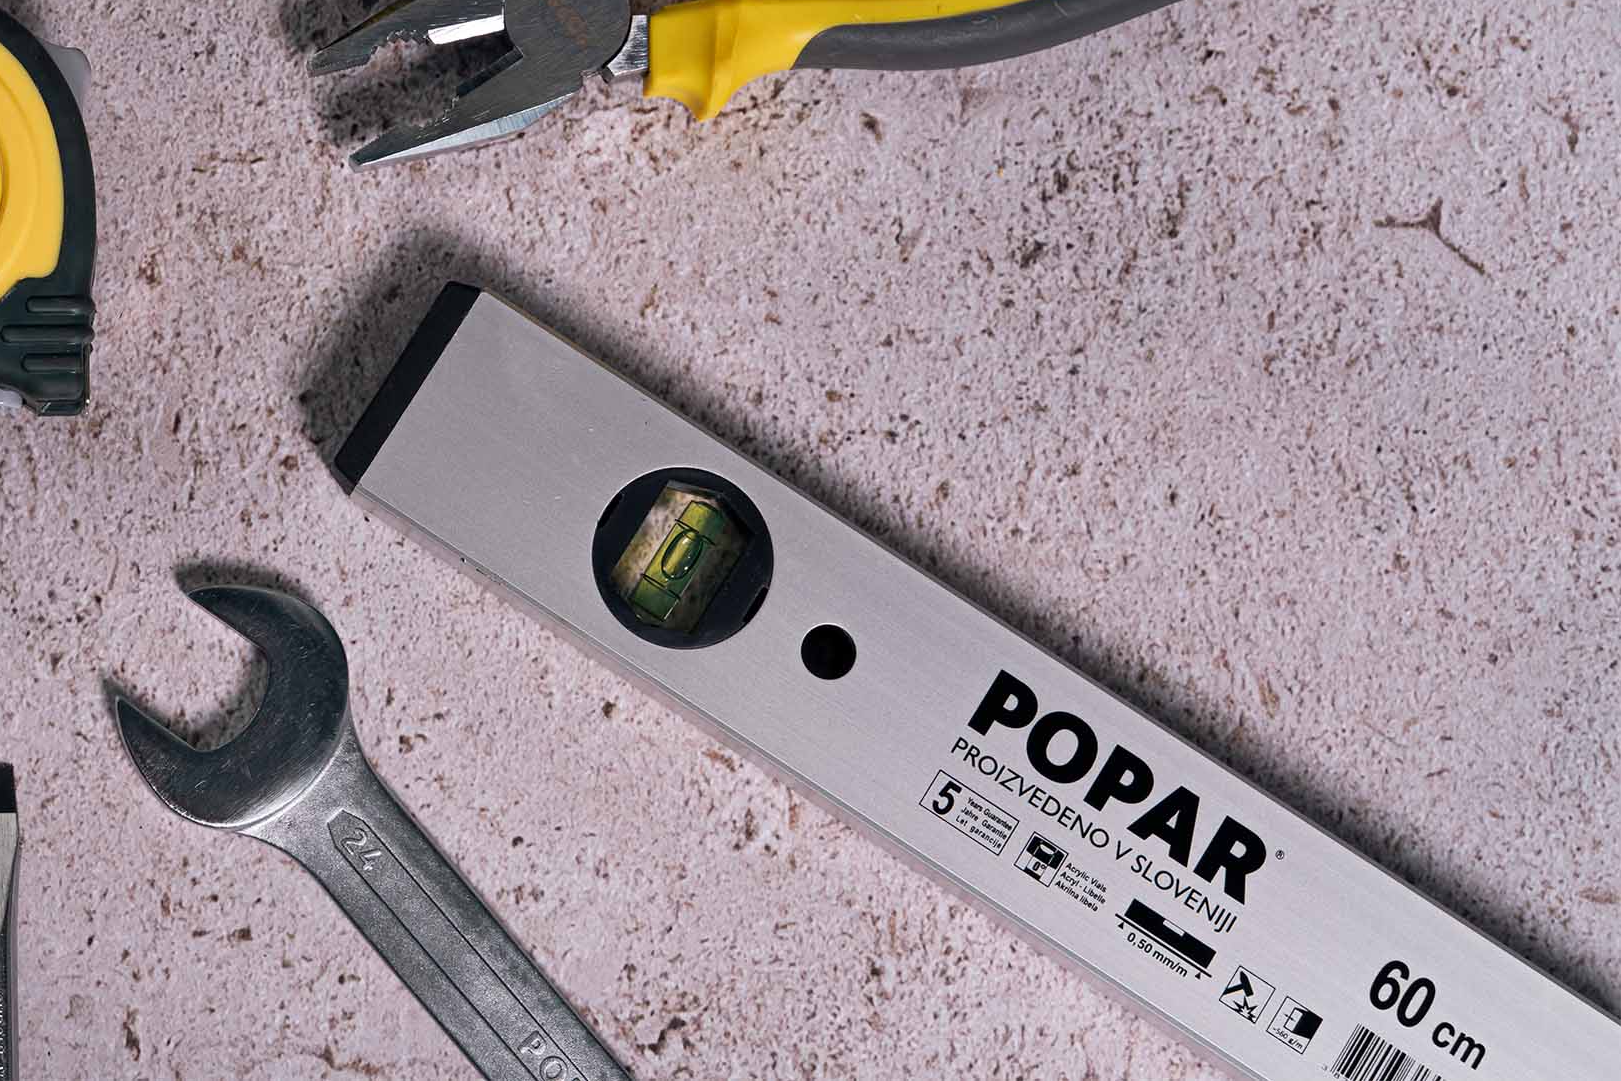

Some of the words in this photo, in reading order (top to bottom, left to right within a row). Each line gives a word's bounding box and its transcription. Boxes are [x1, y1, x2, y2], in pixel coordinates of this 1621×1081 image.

[932, 780, 962, 816] 5
[967, 797, 983, 812] Years
[983, 808, 1013, 831] Guarantee
[951, 737, 1110, 851] PROIZVEDENO
[1115, 838, 1137, 862] V
[1132, 853, 1237, 934] SLOVENIJI
[955, 816, 967, 827] Let
[970, 825, 1002, 850] garancije
[961, 807, 979, 821] Jahre
[981, 819, 1007, 840] Garantie
[339, 827, 382, 871] 24
[1060, 872, 1079, 886] Acryl
[1083, 885, 1106, 904] Libelle
[1065, 863, 1090, 881] Acrylic
[1091, 877, 1107, 893] Vials
[1055, 881, 1079, 900] Akrilna
[1080, 896, 1099, 912] libela
[1127, 932, 1153, 955] 0,50
[1152, 949, 1188, 978] mm/m
[1369, 960, 1436, 1027] 60
[1431, 1021, 1486, 1070] cm
